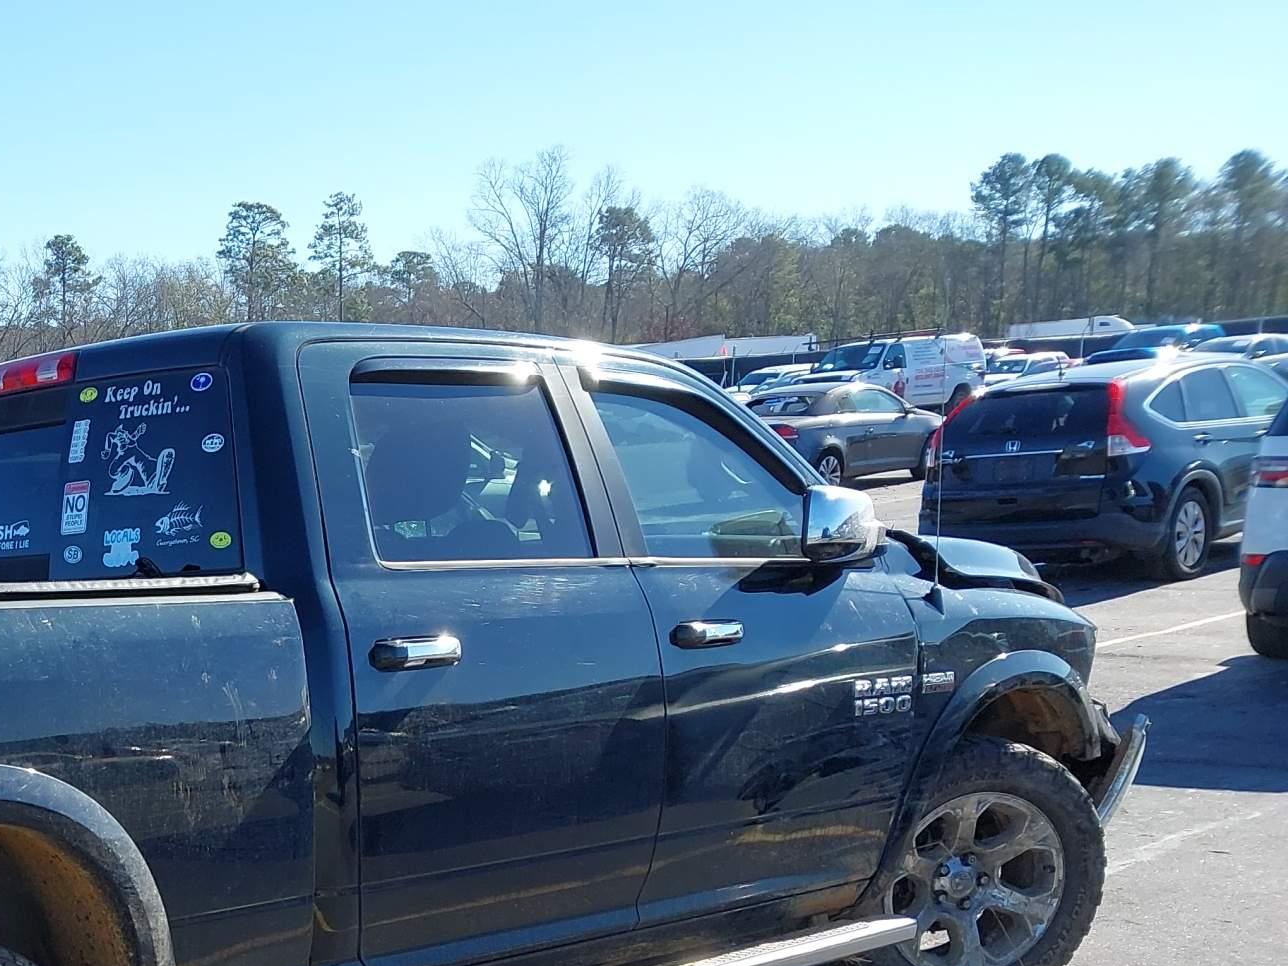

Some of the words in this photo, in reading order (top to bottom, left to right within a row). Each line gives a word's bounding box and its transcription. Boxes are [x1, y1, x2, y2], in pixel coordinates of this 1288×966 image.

[104, 385, 139, 403] Keep
[143, 380, 161, 396] On
[65, 494, 86, 514] NO
[64, 519, 83, 527] PEOPLE
[65, 513, 83, 521] STUPID
[19, 538, 30, 549] LIE
[104, 528, 140, 545] LOCALS
[66, 549, 79, 560] SB
[854, 675, 913, 698] RAM
[854, 694, 912, 717] 1500
